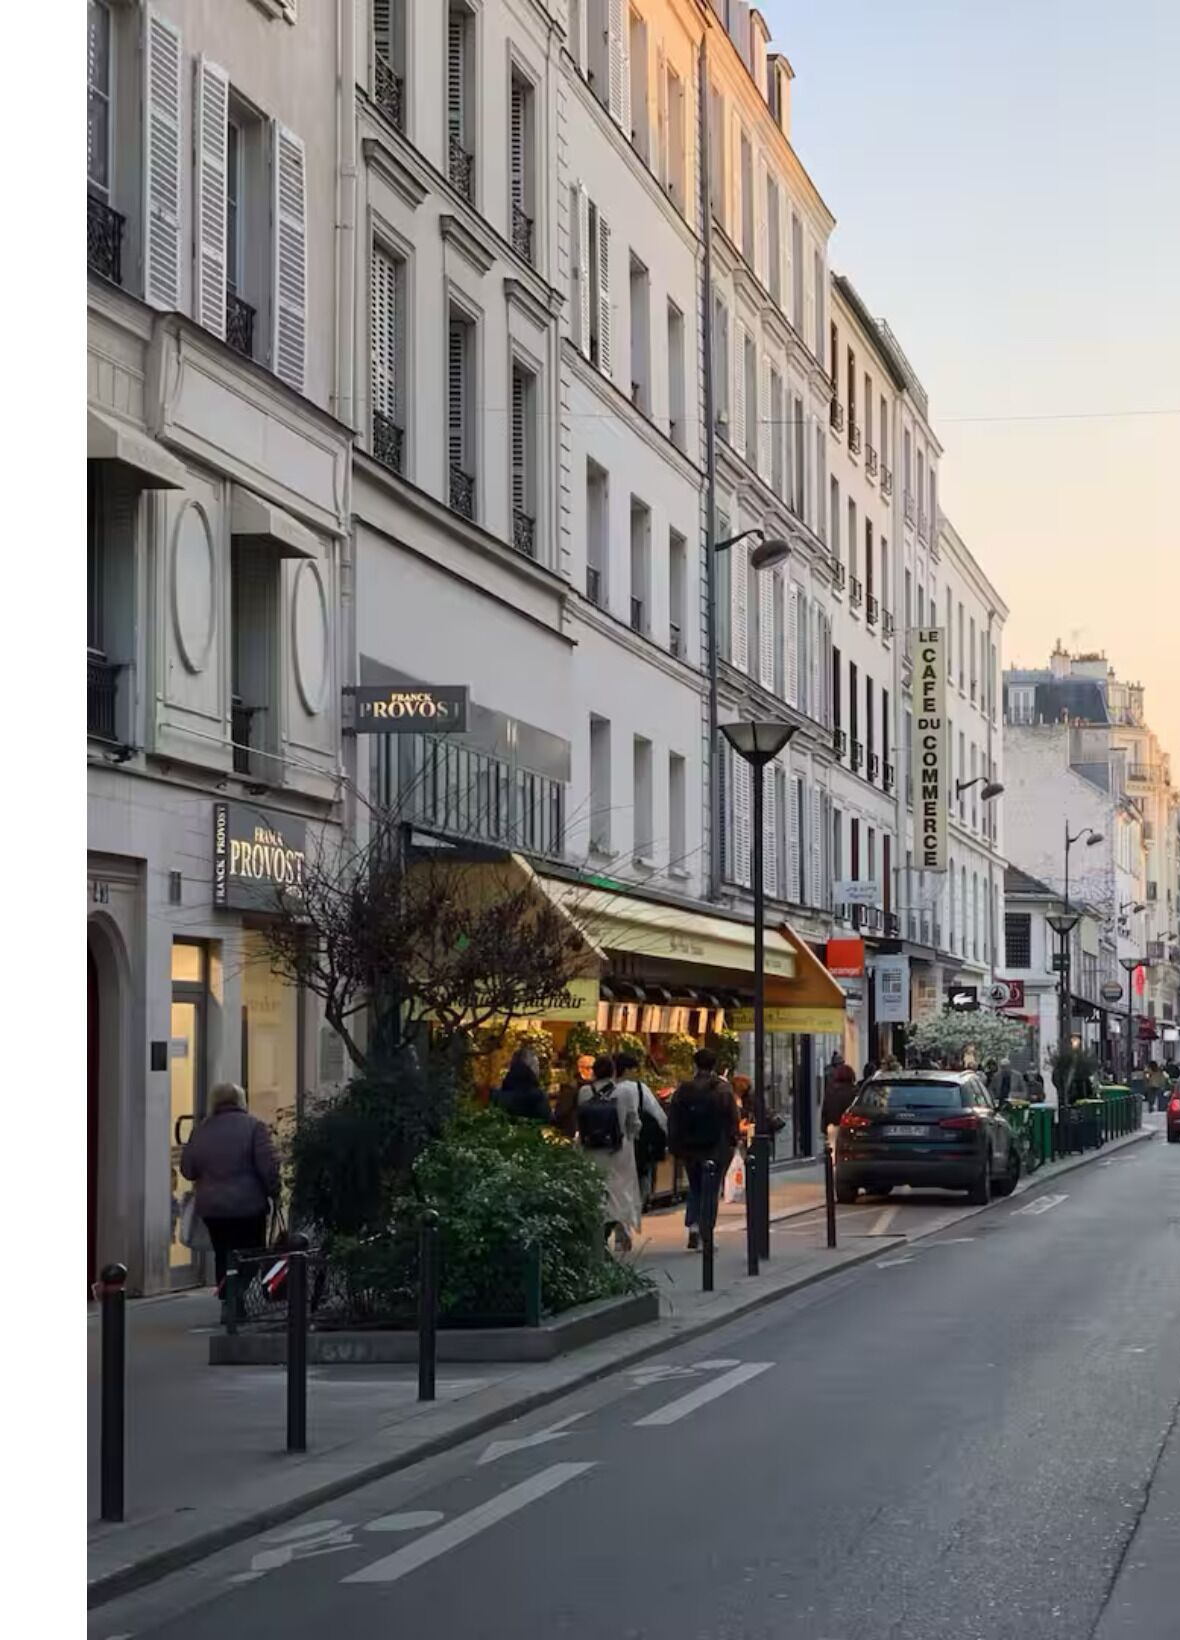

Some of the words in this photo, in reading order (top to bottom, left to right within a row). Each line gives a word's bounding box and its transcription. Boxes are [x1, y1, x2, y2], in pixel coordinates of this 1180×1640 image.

[919, 631, 938, 643] LE
[391, 693, 432, 701] FRANCK
[922, 648, 936, 712] CAFE
[360, 701, 463, 718] PROVOST
[918, 719, 940, 730] DU
[922, 736, 938, 866] COMMERCE
[216, 807, 225, 854] PROVOST
[216, 860, 225, 903] FRANCK
[230, 840, 305, 884] PROVOST
